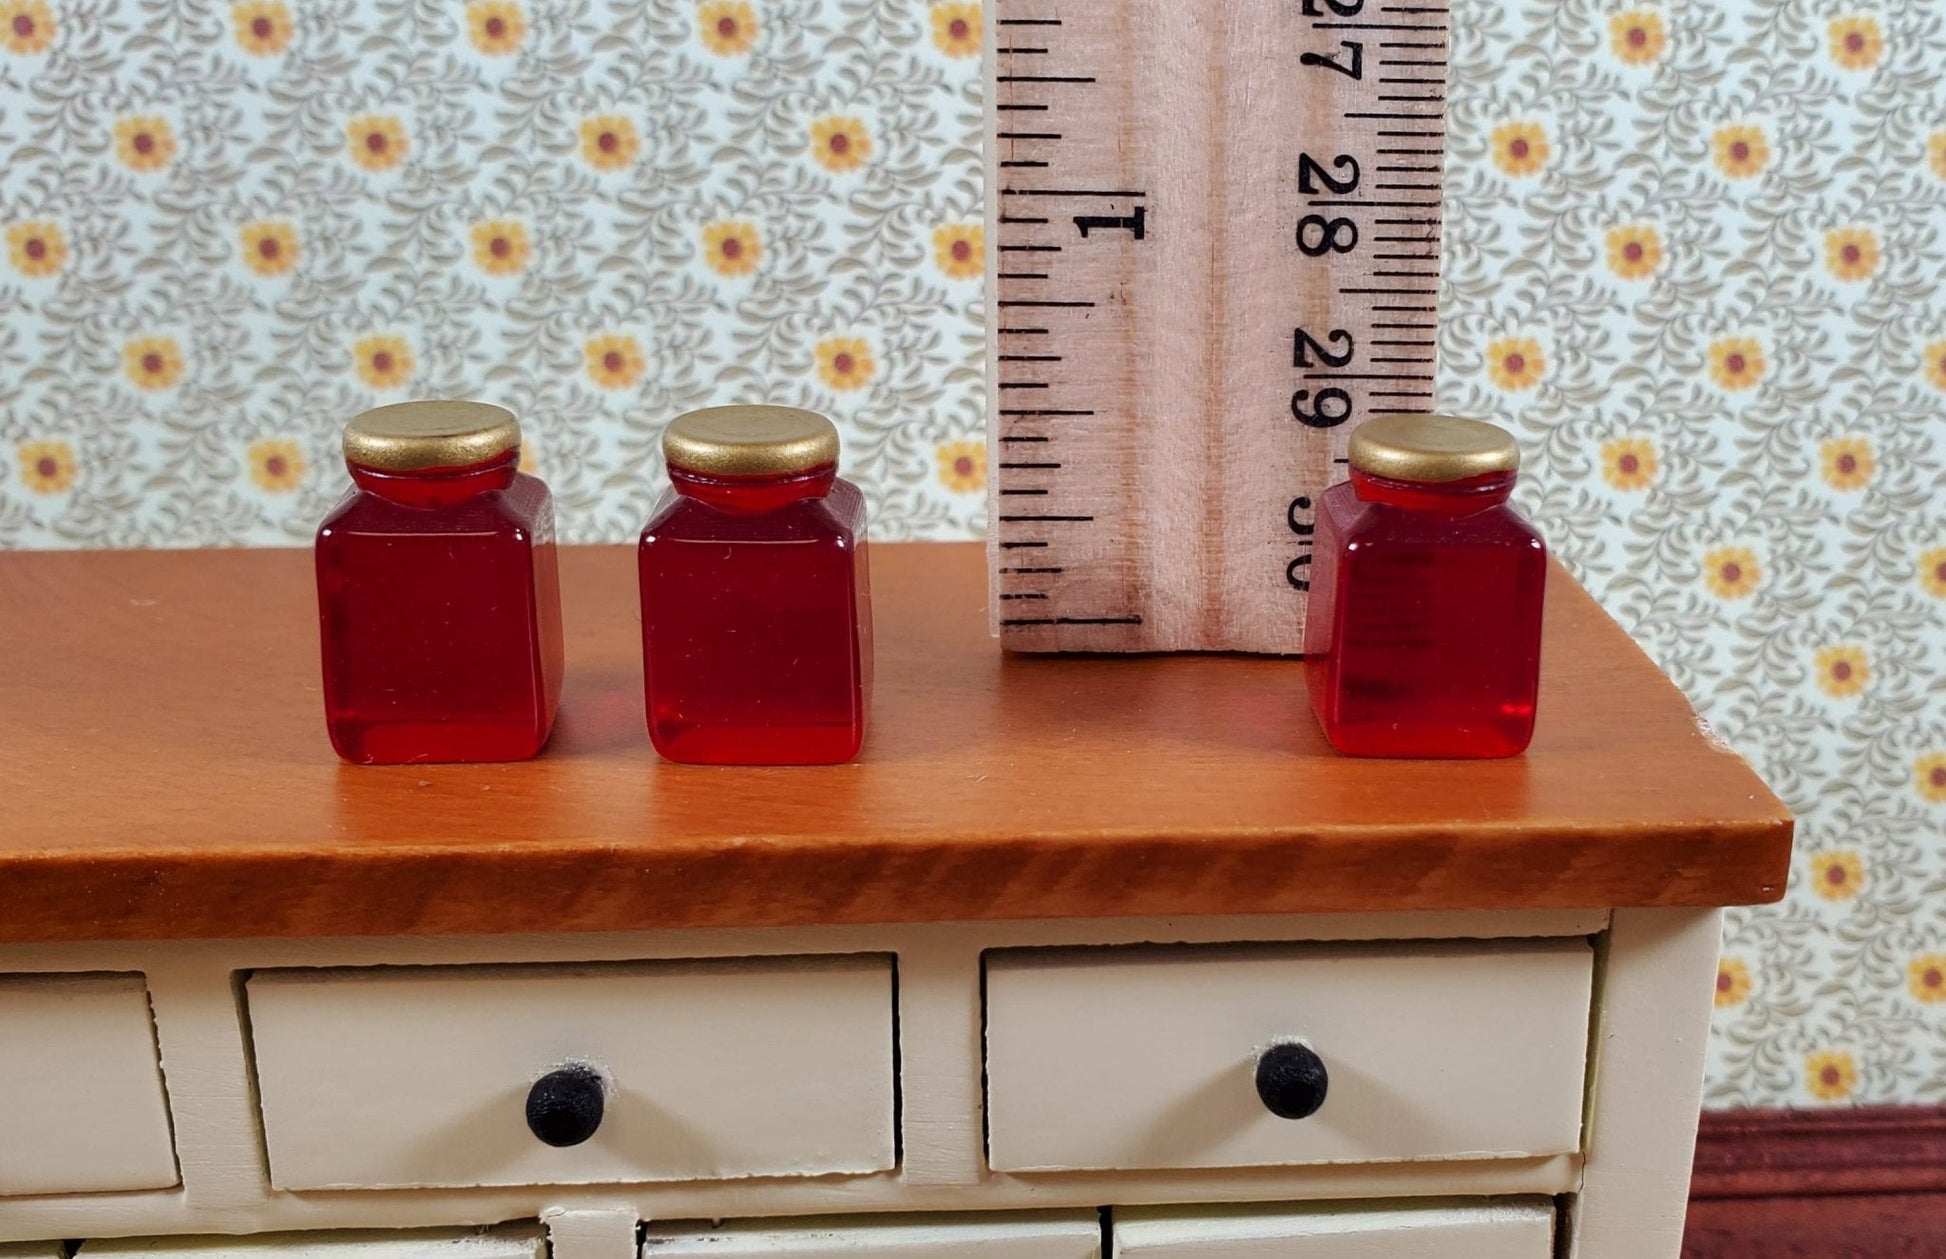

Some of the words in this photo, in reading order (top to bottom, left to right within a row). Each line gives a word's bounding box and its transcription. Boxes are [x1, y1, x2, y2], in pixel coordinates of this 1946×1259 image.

[1073, 206, 1145, 239] 1
[1296, 152, 1360, 257] 28
[1291, 327, 1354, 428] 29
